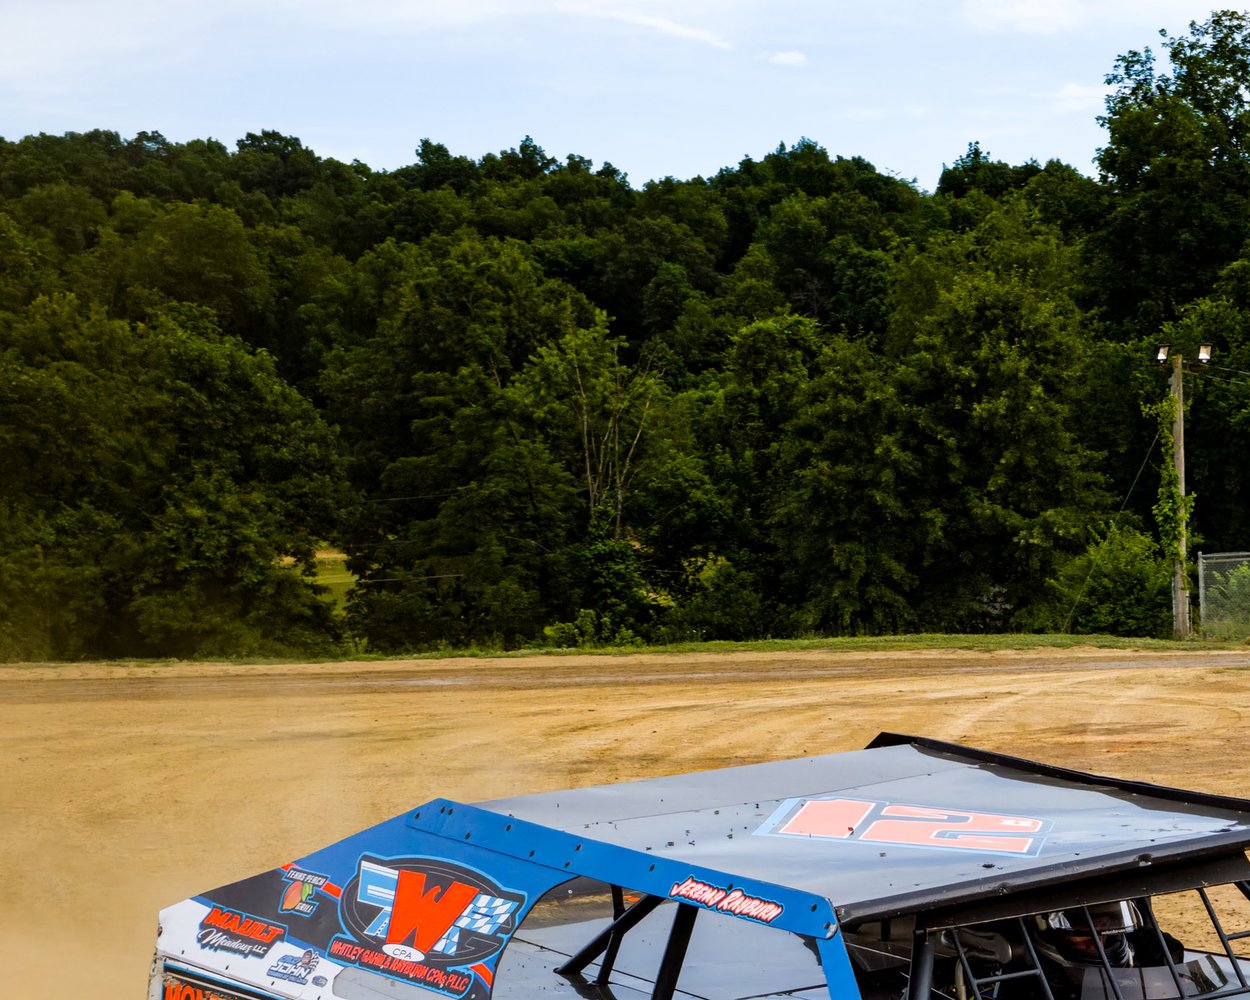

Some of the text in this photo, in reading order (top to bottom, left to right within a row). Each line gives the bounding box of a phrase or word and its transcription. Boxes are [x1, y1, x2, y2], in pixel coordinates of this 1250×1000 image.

[779, 799, 1042, 852] 12
[204, 908, 284, 943] MAULT
[252, 944, 267, 954] LLC
[392, 947, 412, 960] CPA
[270, 963, 310, 979] JOHN
[330, 940, 362, 960] WHITLEY
[383, 955, 391, 968] &
[390, 957, 427, 979] RAYBURN
[446, 974, 469, 990] PLLC
